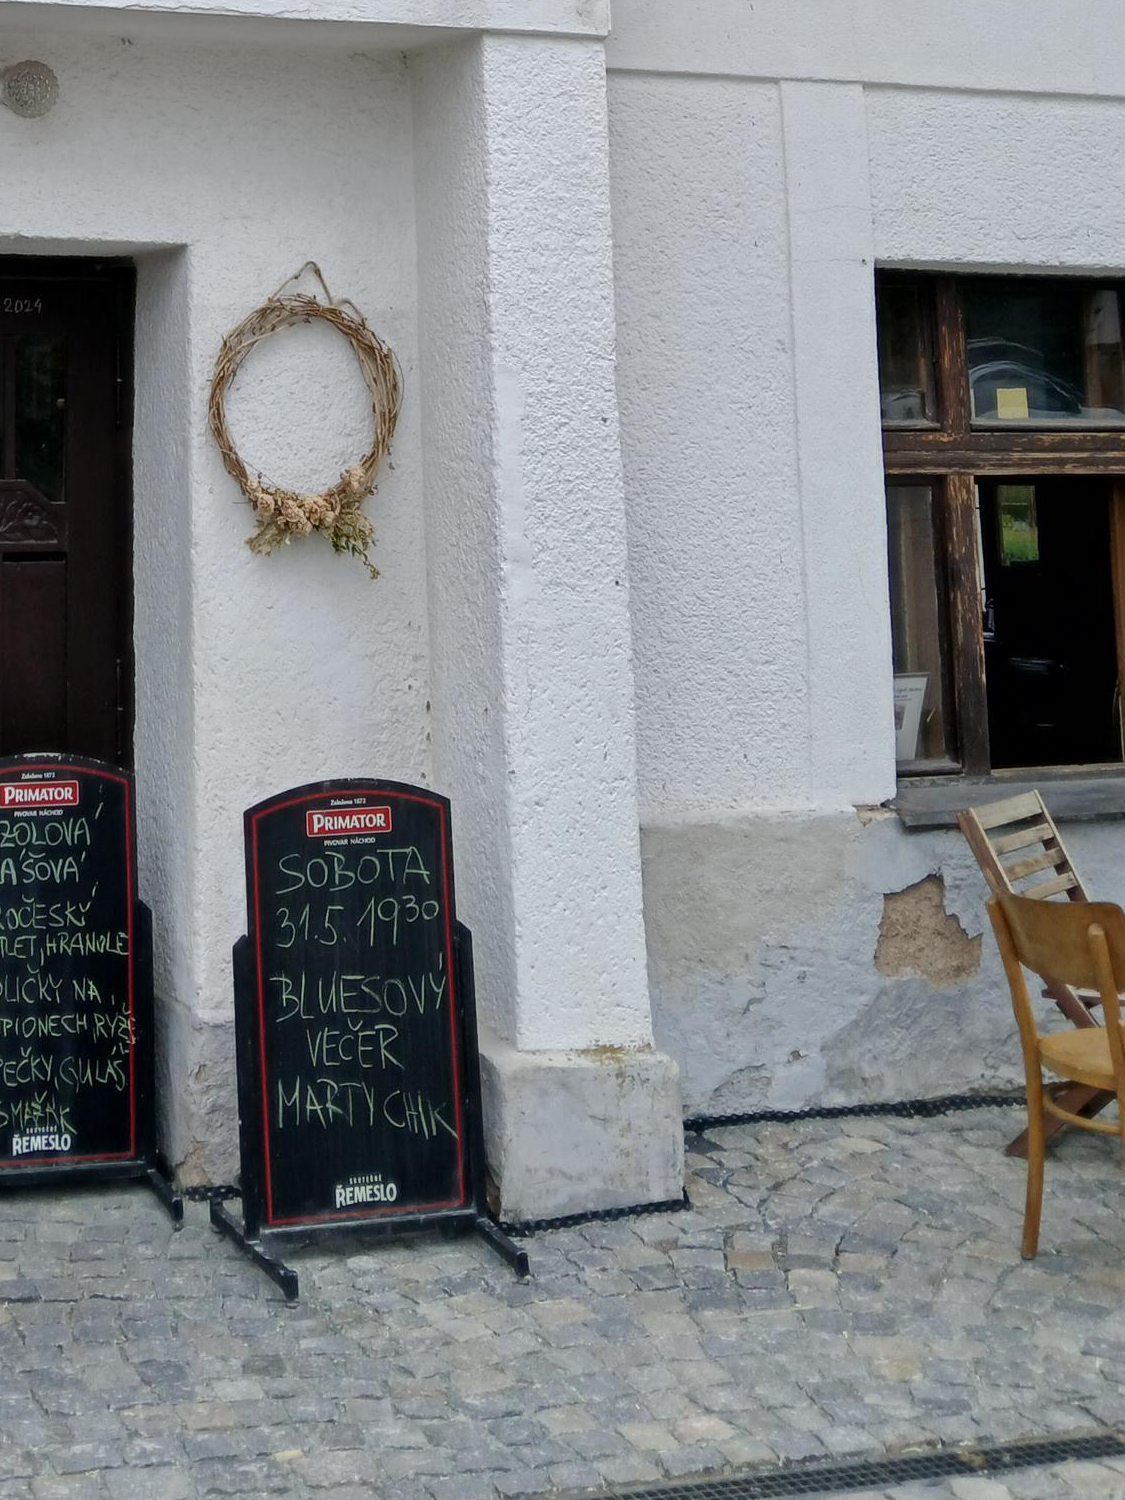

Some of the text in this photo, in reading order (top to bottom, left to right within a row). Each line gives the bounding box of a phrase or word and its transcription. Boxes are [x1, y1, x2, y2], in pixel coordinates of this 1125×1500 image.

[275, 846, 431, 895] SOBOTA
[72, 976, 102, 1004] NA
[269, 952, 447, 1023] BLUESOVÝ
[306, 1016, 405, 1070] VEČER
[277, 1075, 375, 1129] MARTY
[12, 1133, 72, 1157] ŘEMESLO
[335, 1182, 398, 1209] ŘEMESLO
